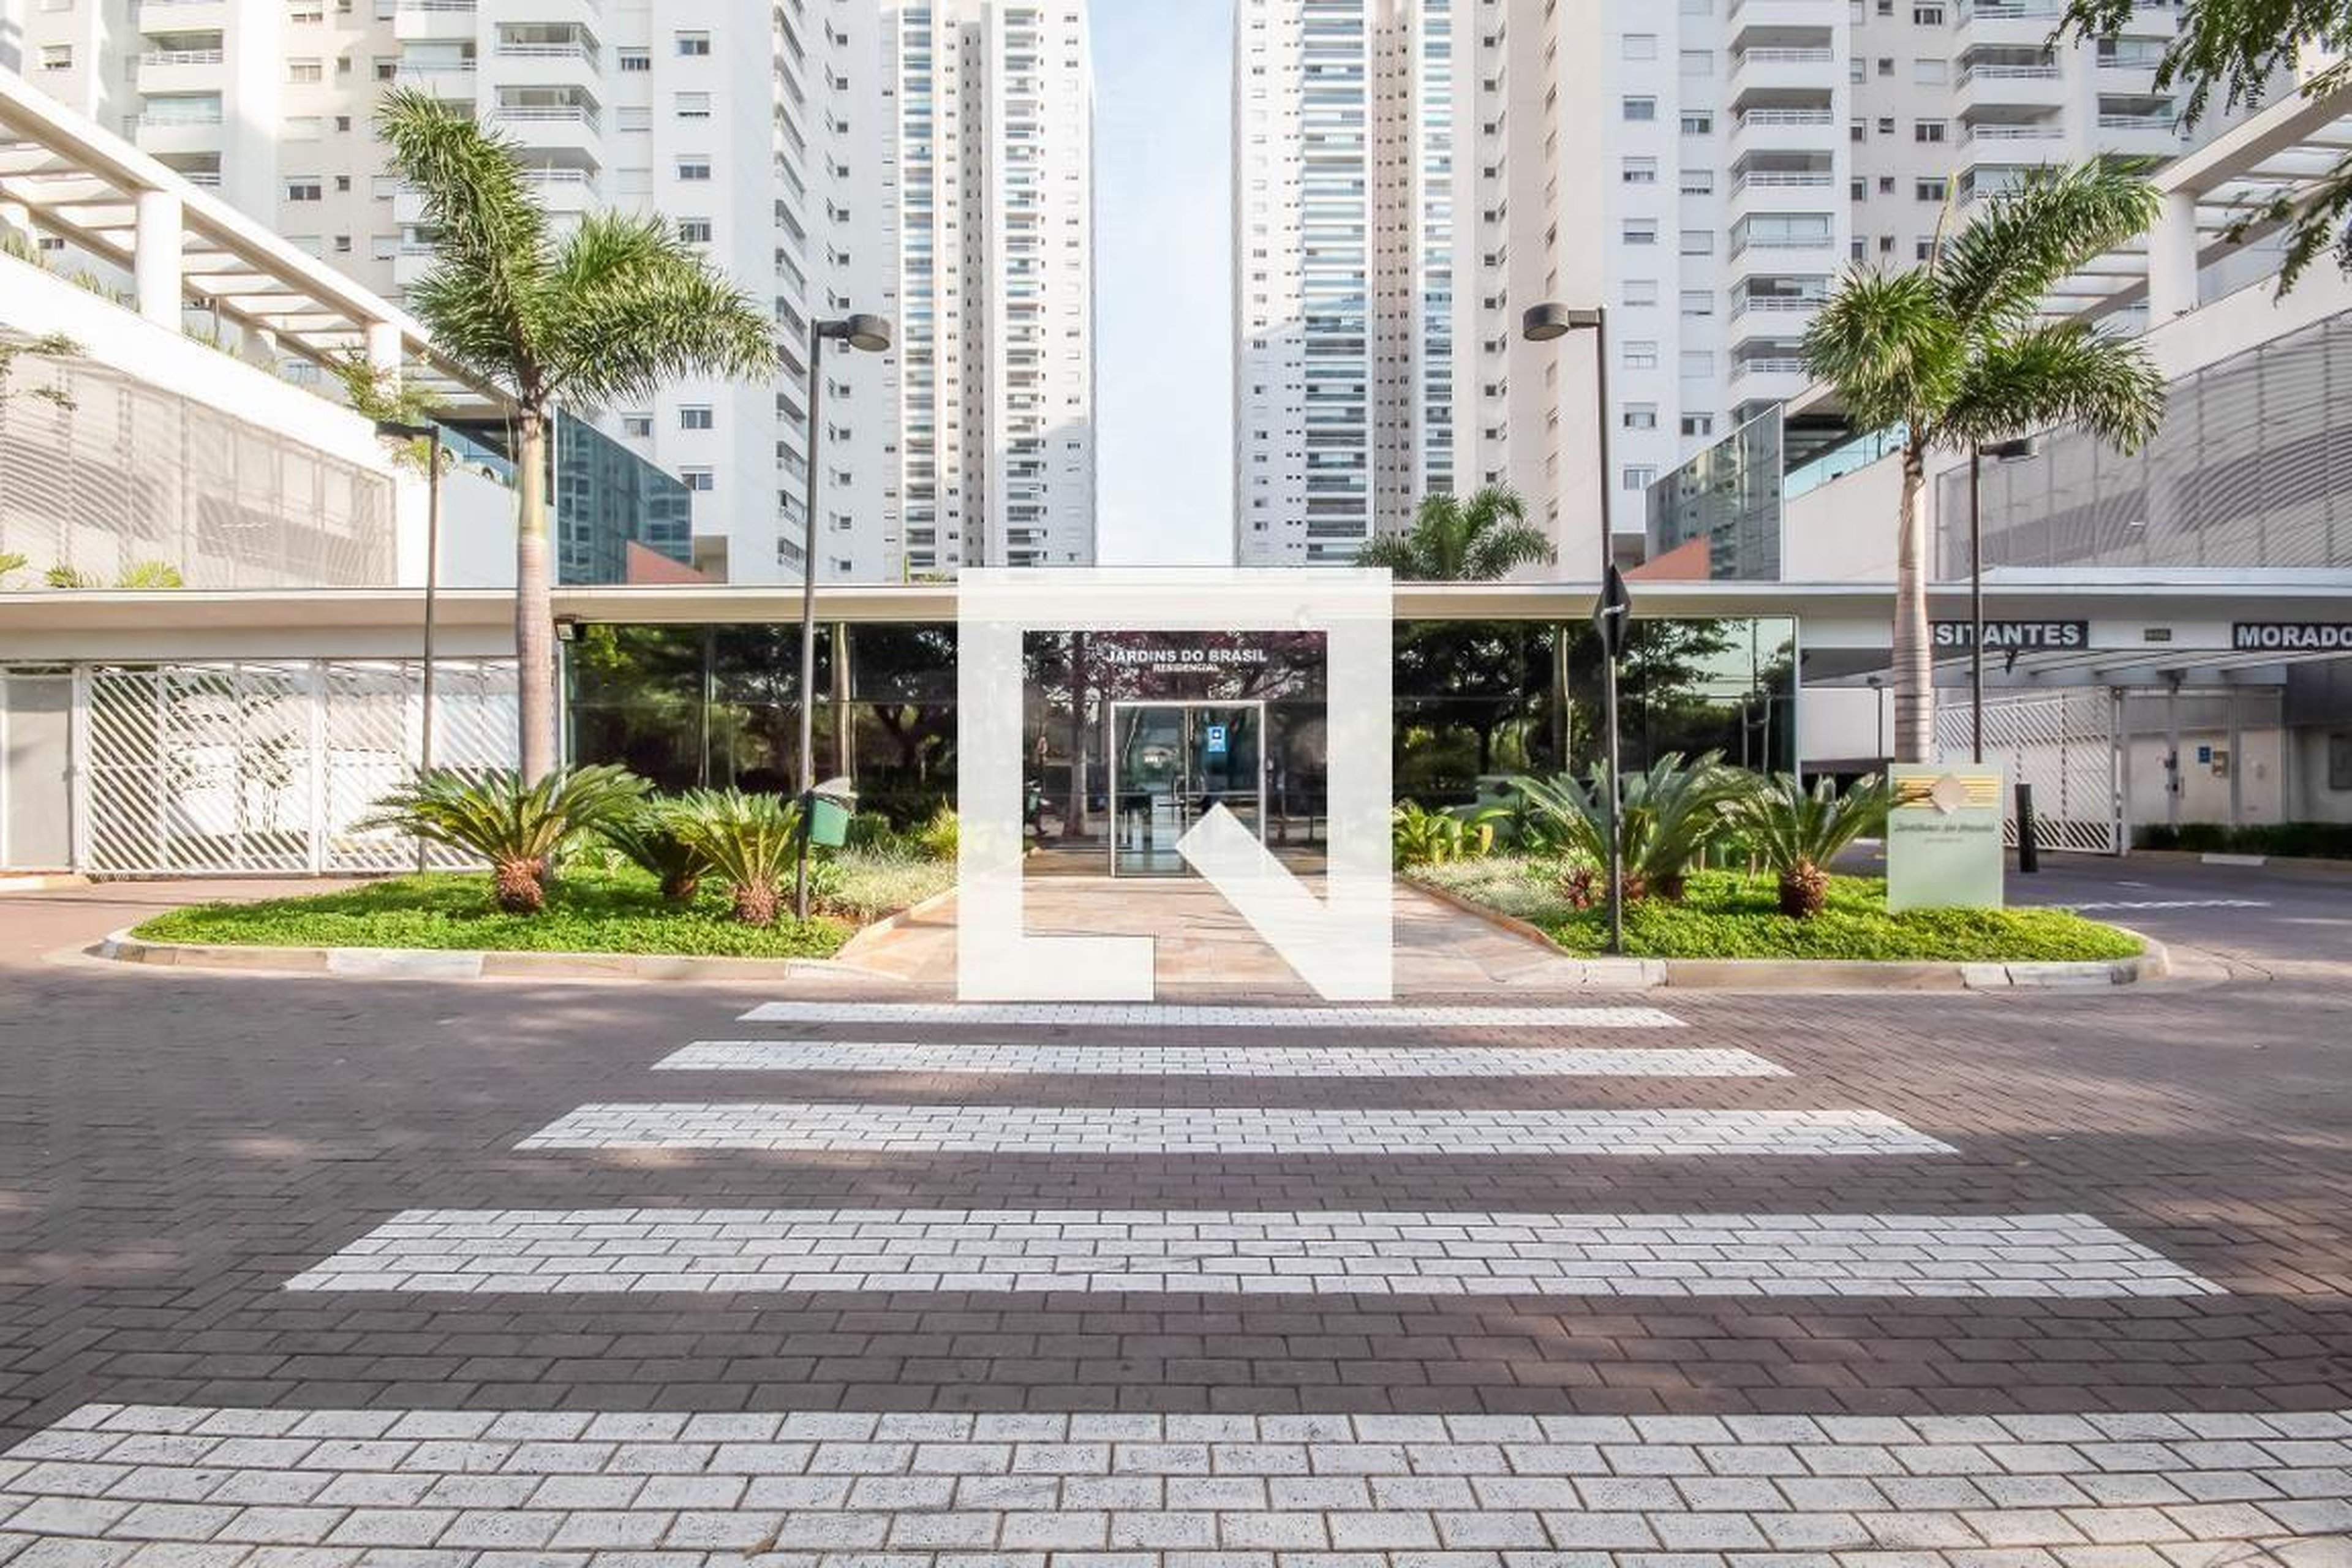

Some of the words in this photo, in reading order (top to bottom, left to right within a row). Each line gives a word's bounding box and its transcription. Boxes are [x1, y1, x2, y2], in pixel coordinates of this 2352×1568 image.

[1929, 624, 2079, 645] ISIANTES
[1106, 650, 1177, 662] JARDINS
[1181, 650, 1204, 662] DO
[1208, 649, 1267, 662] BRASIL
